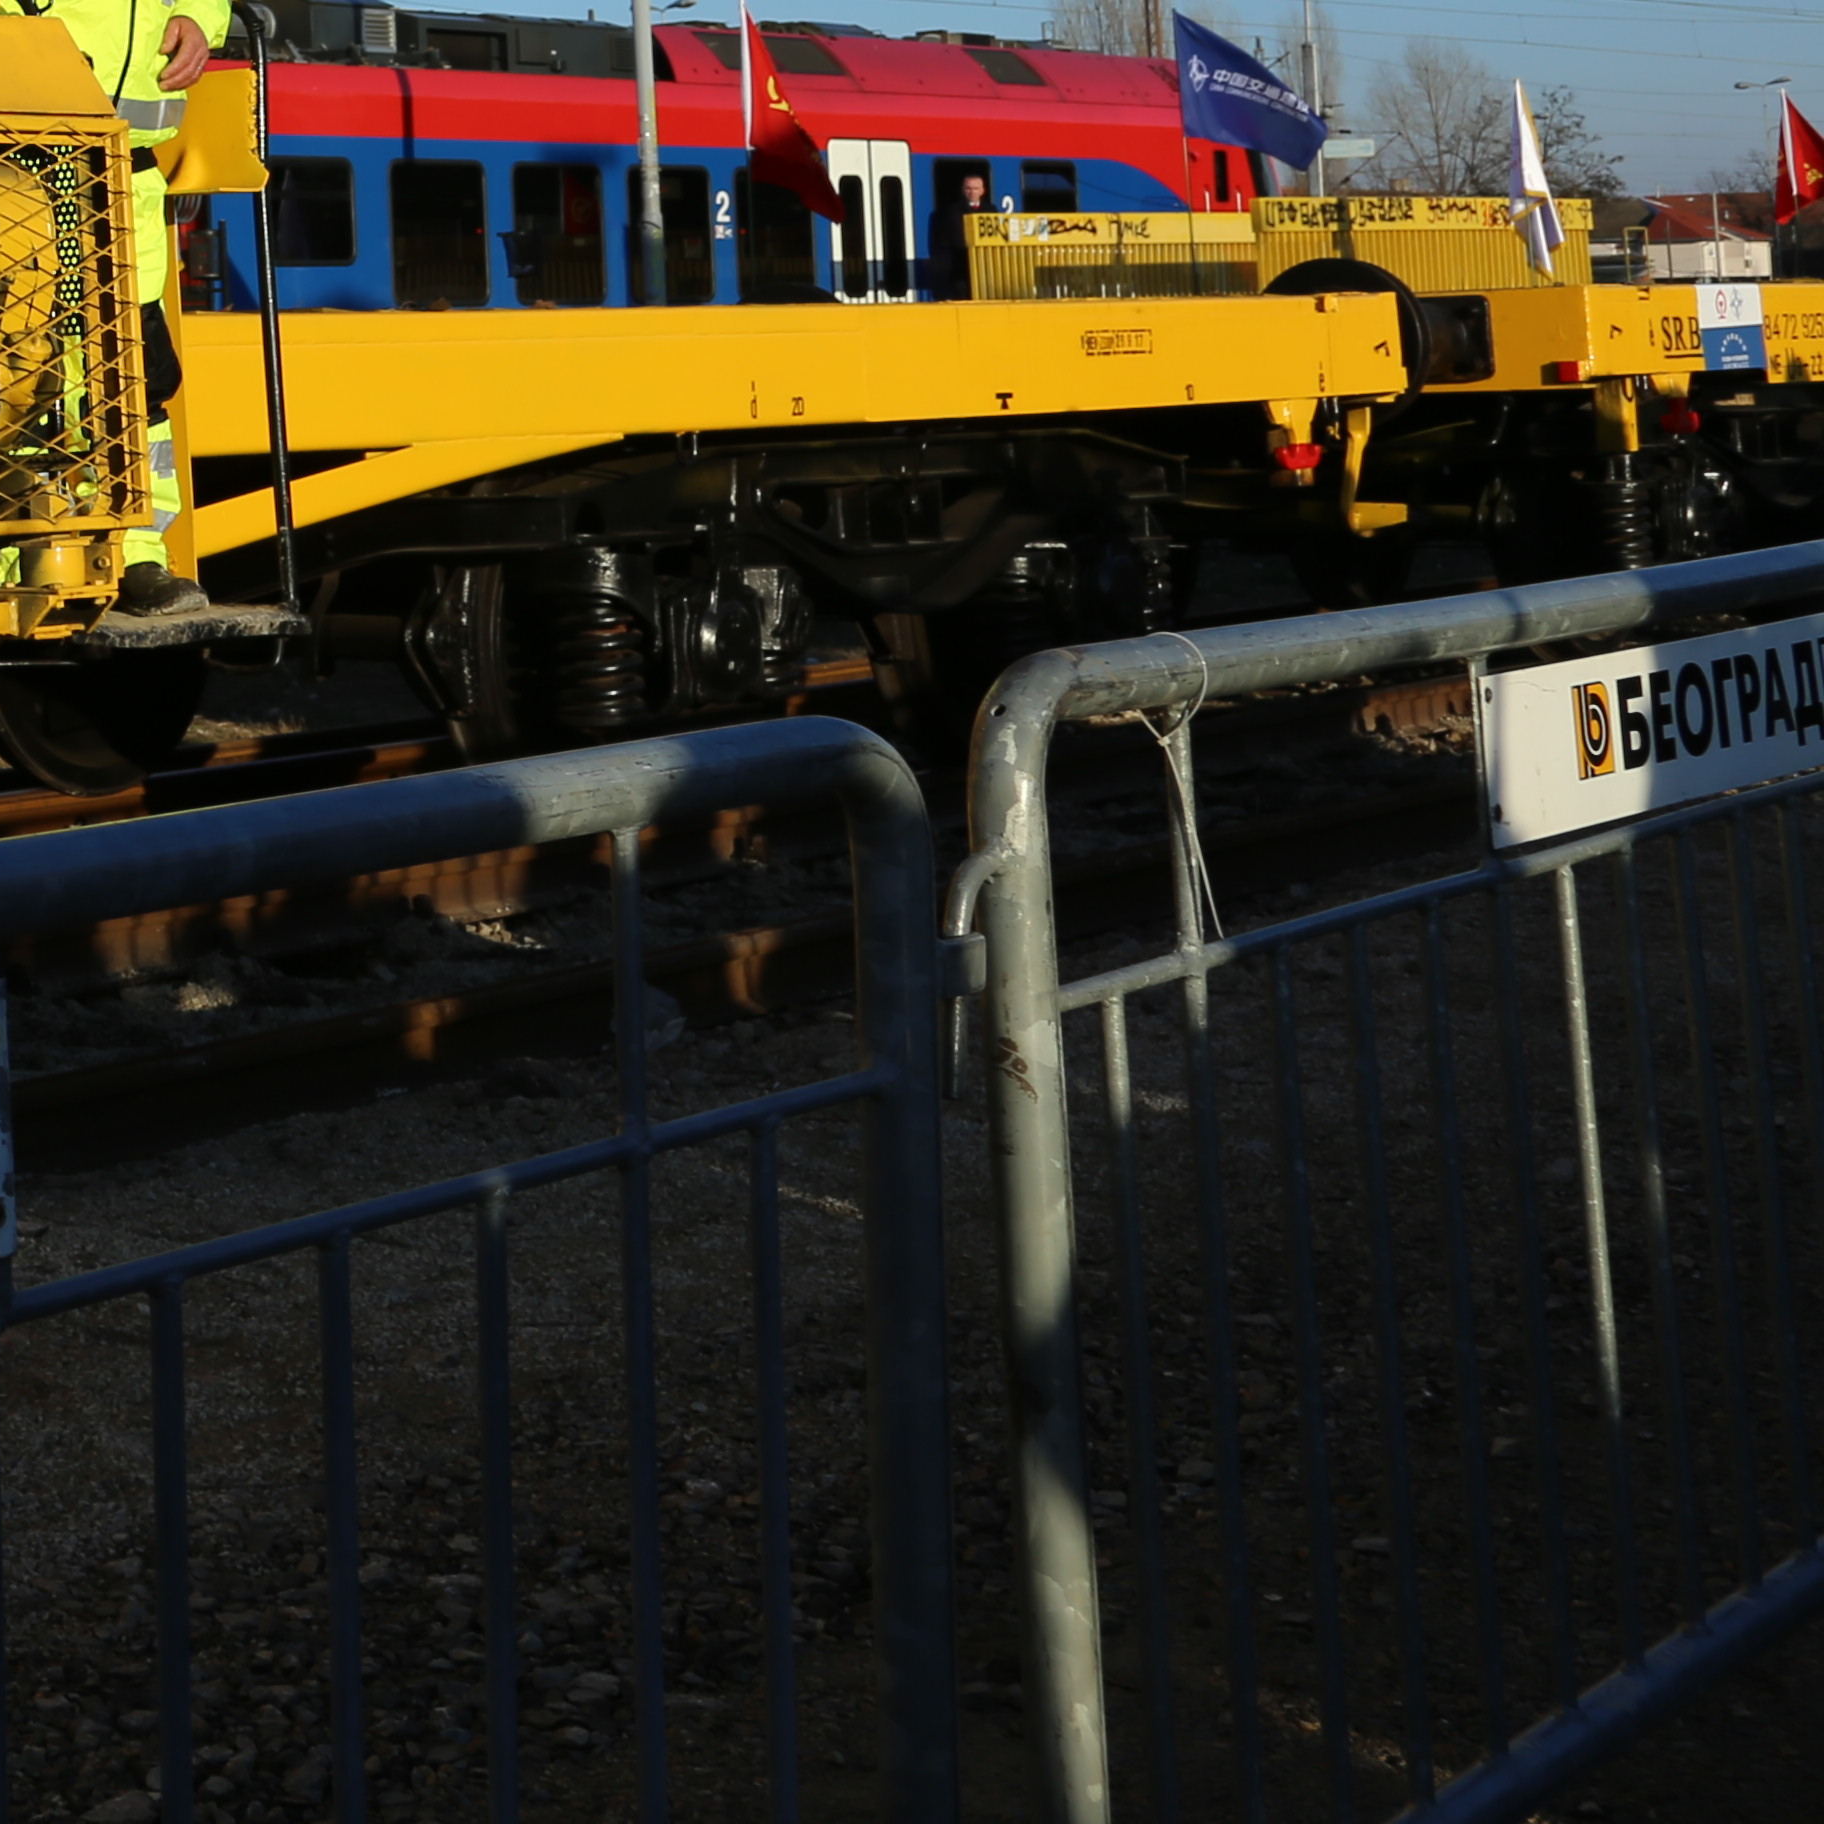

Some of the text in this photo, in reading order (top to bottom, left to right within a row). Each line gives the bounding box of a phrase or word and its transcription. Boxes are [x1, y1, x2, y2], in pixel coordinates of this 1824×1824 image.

[715, 190, 731, 223] 2
[1661, 316, 1702, 352] SRB
[1616, 636, 1824, 771] БЕОГРАД
